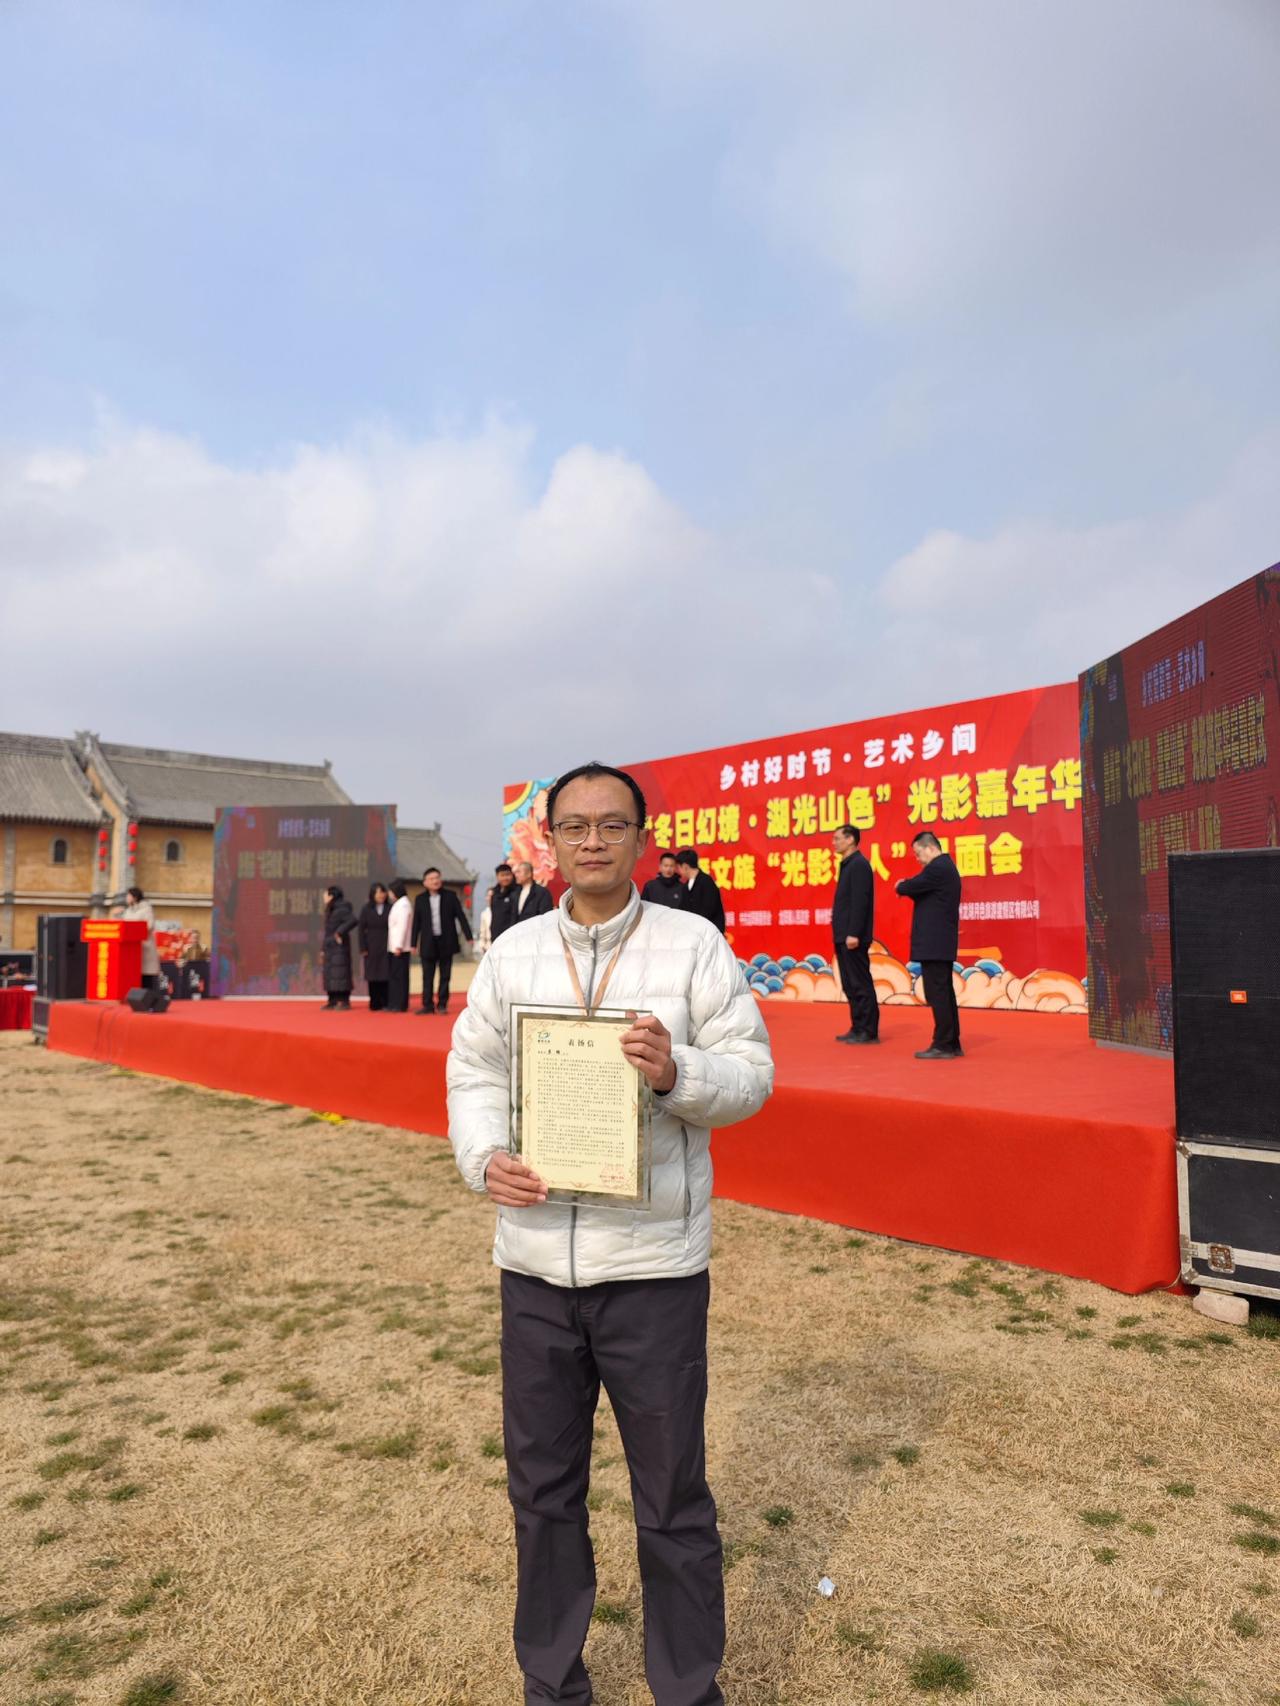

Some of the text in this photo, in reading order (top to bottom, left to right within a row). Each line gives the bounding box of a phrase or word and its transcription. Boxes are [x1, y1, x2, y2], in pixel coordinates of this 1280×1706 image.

[720, 722, 977, 791] 乡村好时节·艺术乡间
